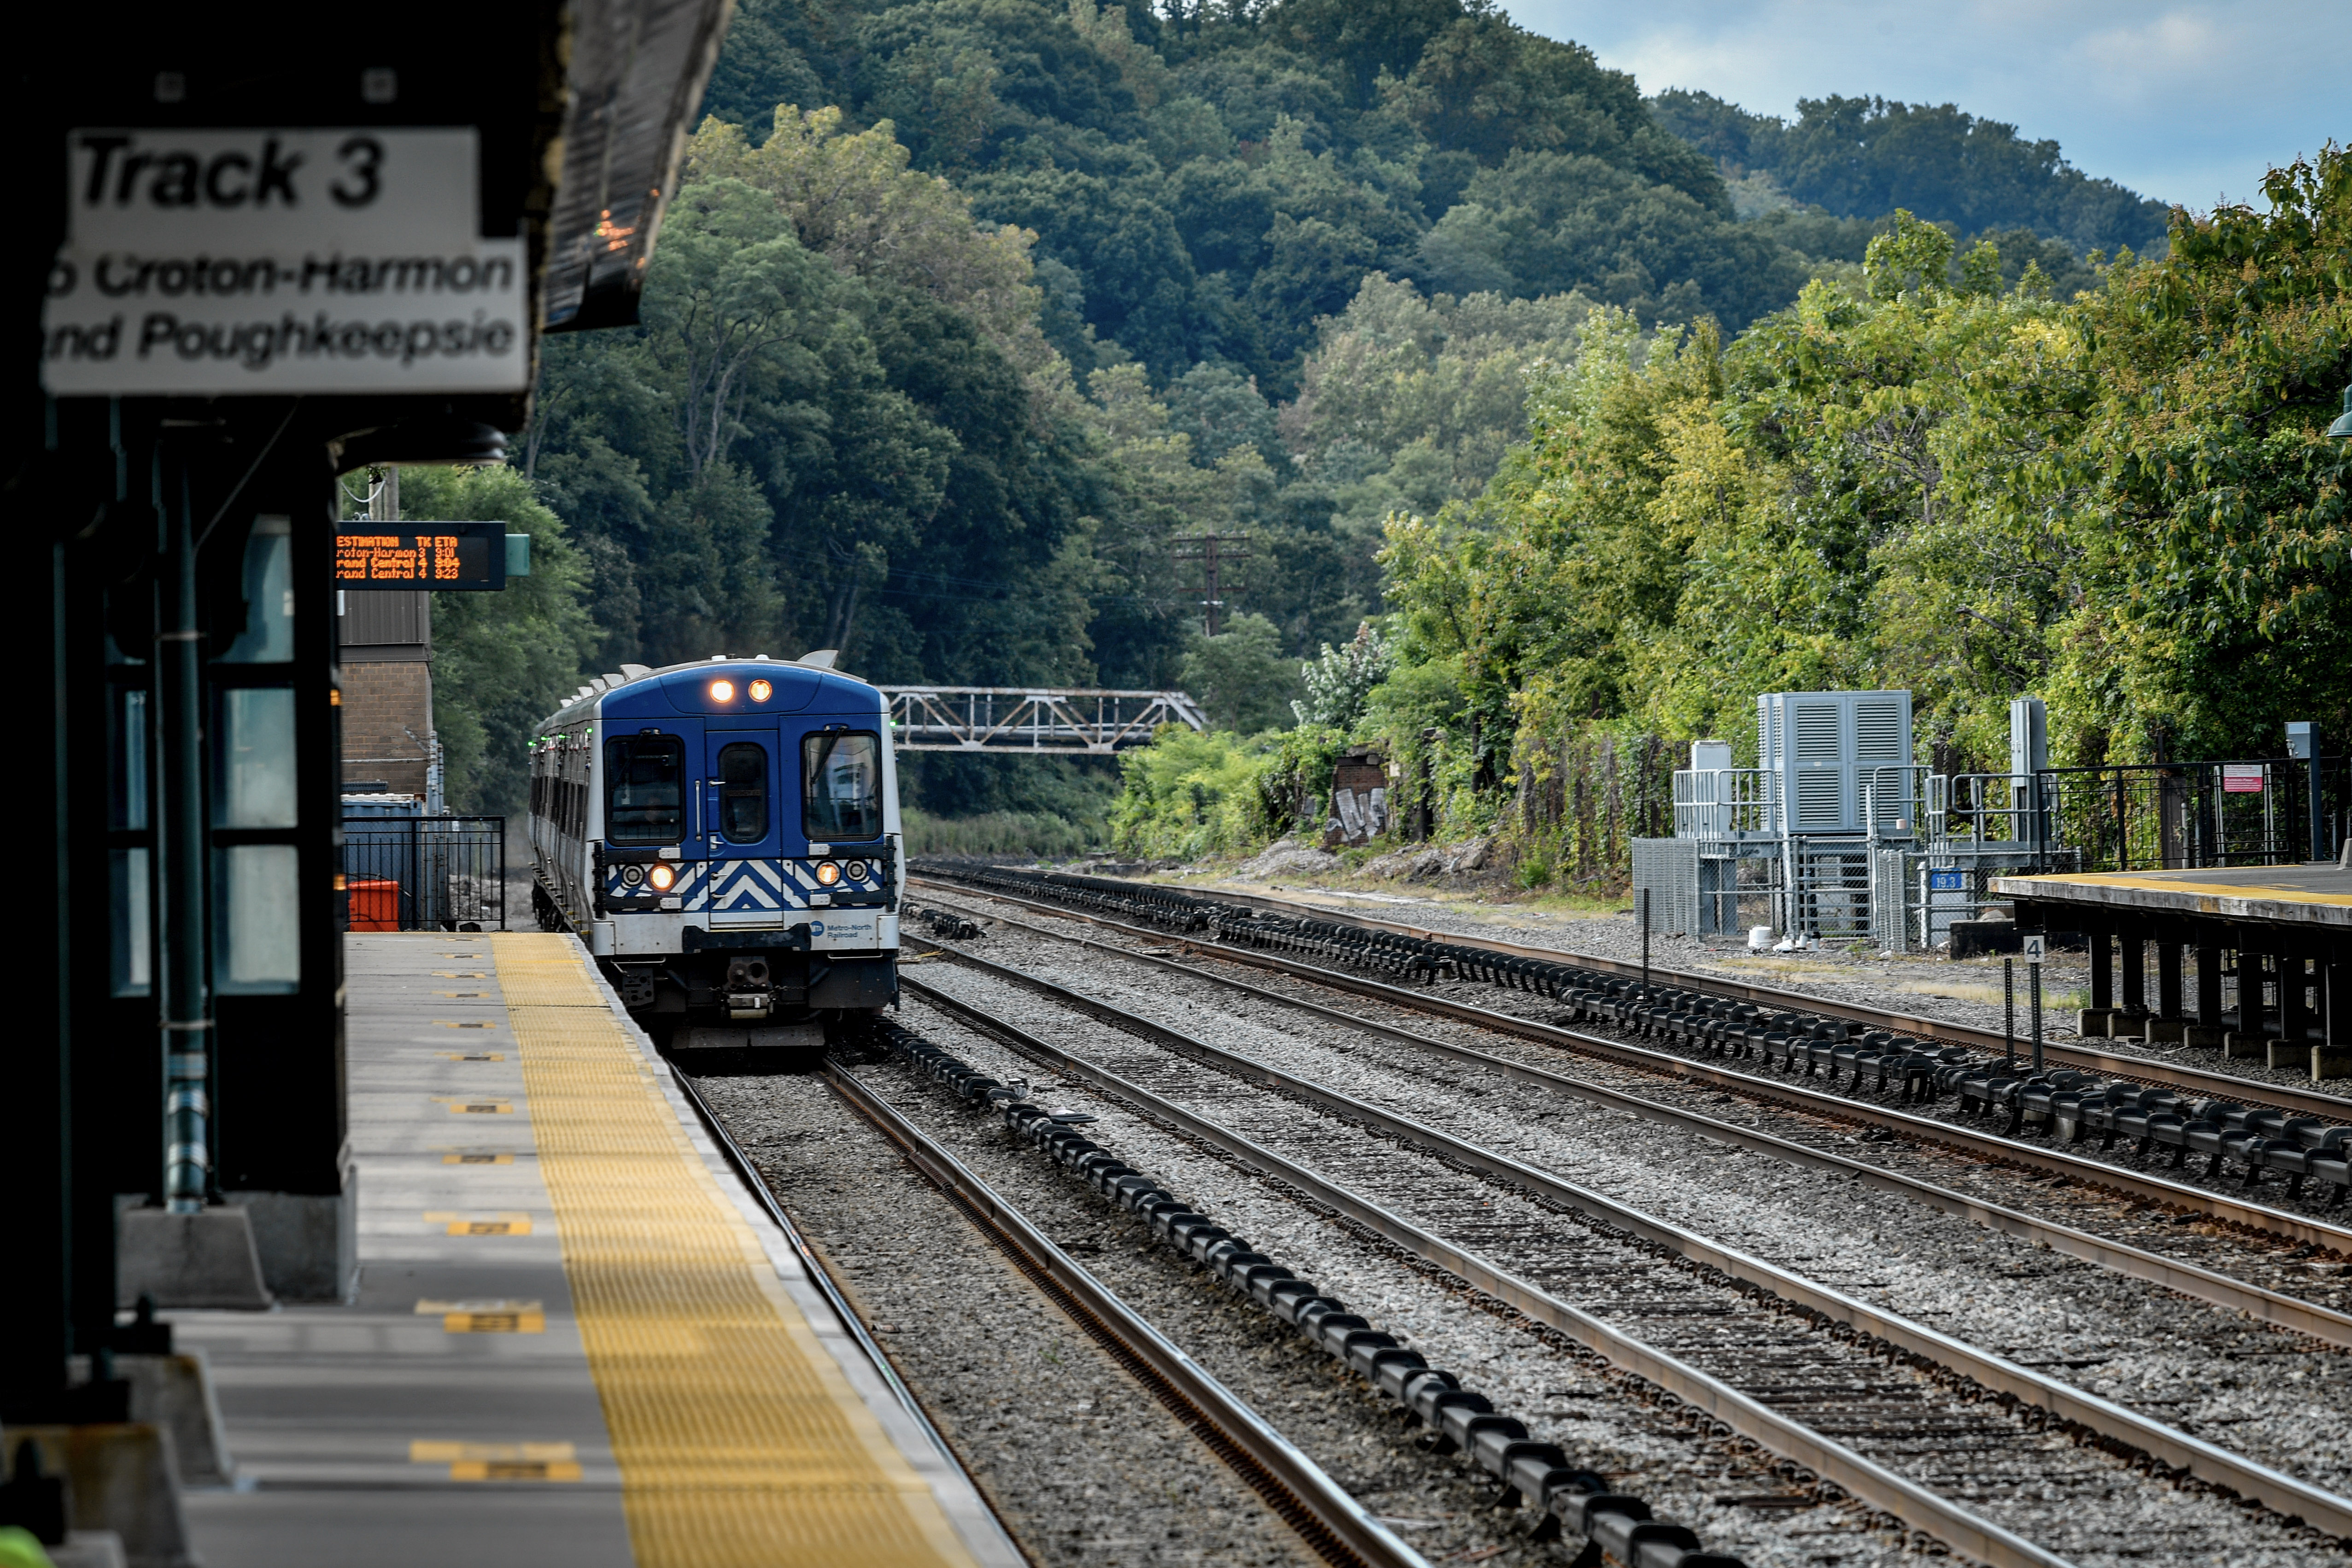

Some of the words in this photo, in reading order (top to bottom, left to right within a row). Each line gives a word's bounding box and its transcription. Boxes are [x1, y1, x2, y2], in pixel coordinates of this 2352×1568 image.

[78, 134, 305, 209] Track
[328, 135, 385, 209] 3
[47, 259, 79, 298] o
[94, 251, 513, 298] Croton-Harmon
[48, 310, 125, 361] nd
[137, 307, 515, 372] Poughkeepsie
[336, 536, 399, 547] ESTINATION
[415, 536, 432, 547] TK
[434, 536, 458, 547] ETA
[336, 547, 417, 558] roton-Harmon
[418, 547, 426, 558] 3
[435, 547, 455, 558] 9:01
[336, 557, 367, 568] rand
[371, 556, 415, 568] Central
[418, 557, 428, 568] 4
[434, 557, 461, 568] 9:04
[336, 568, 366, 579] rand
[371, 568, 415, 579] Central
[418, 568, 427, 579] 4
[434, 568, 459, 579] 9:23
[1936, 877, 1956, 888] 19.3
[2027, 940, 2042, 958] 4
